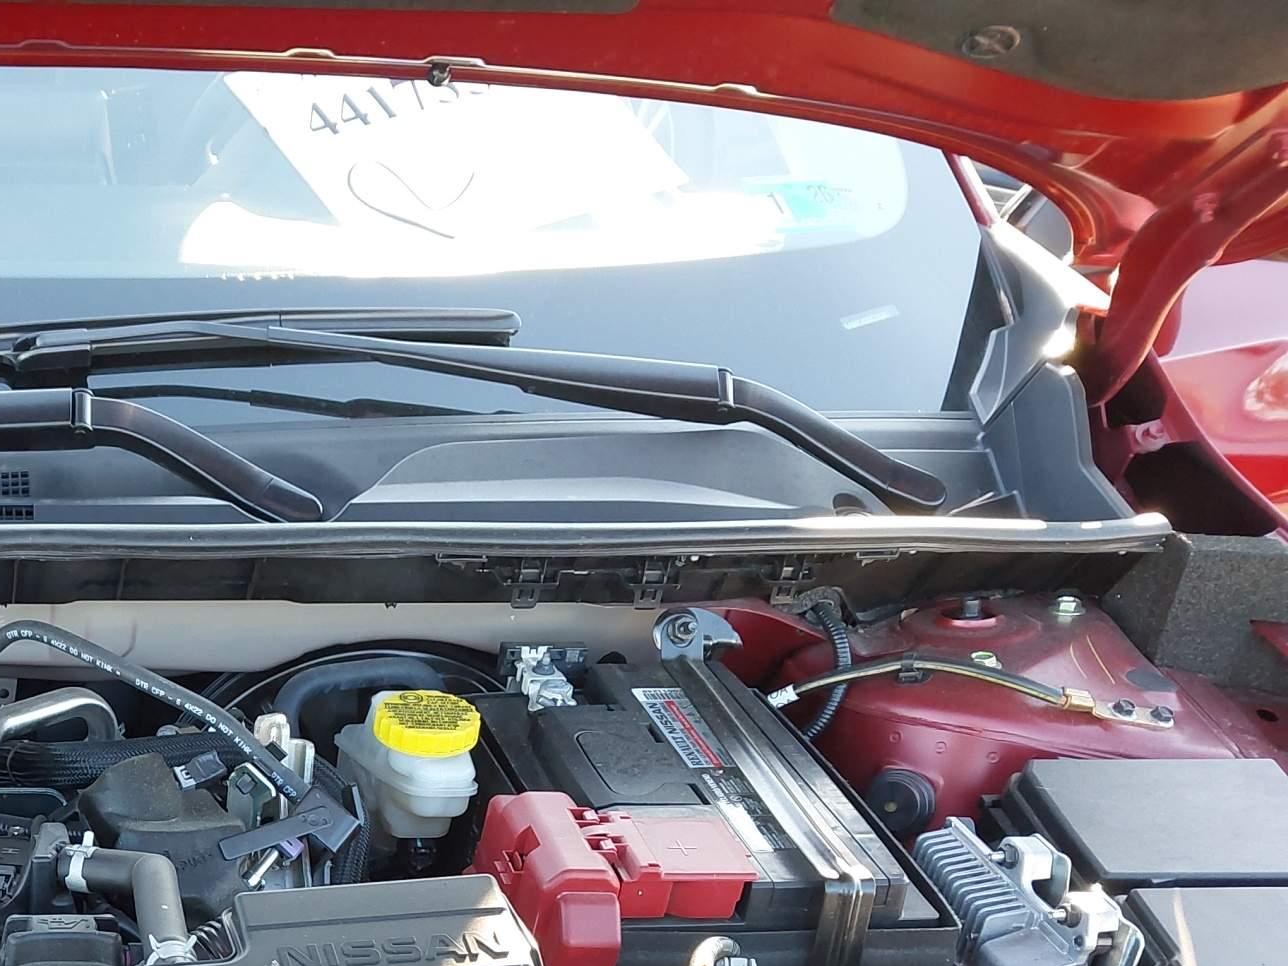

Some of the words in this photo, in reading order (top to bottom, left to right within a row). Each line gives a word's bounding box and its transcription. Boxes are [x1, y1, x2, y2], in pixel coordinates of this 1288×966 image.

[80, 653, 94, 663] NOT
[95, 659, 114, 673] KINK
[205, 713, 217, 724] DO
[218, 722, 234, 736] NOT
[233, 736, 253, 755] KINK
[647, 702, 678, 734] NISSAN
[673, 734, 704, 766] RENAULT
